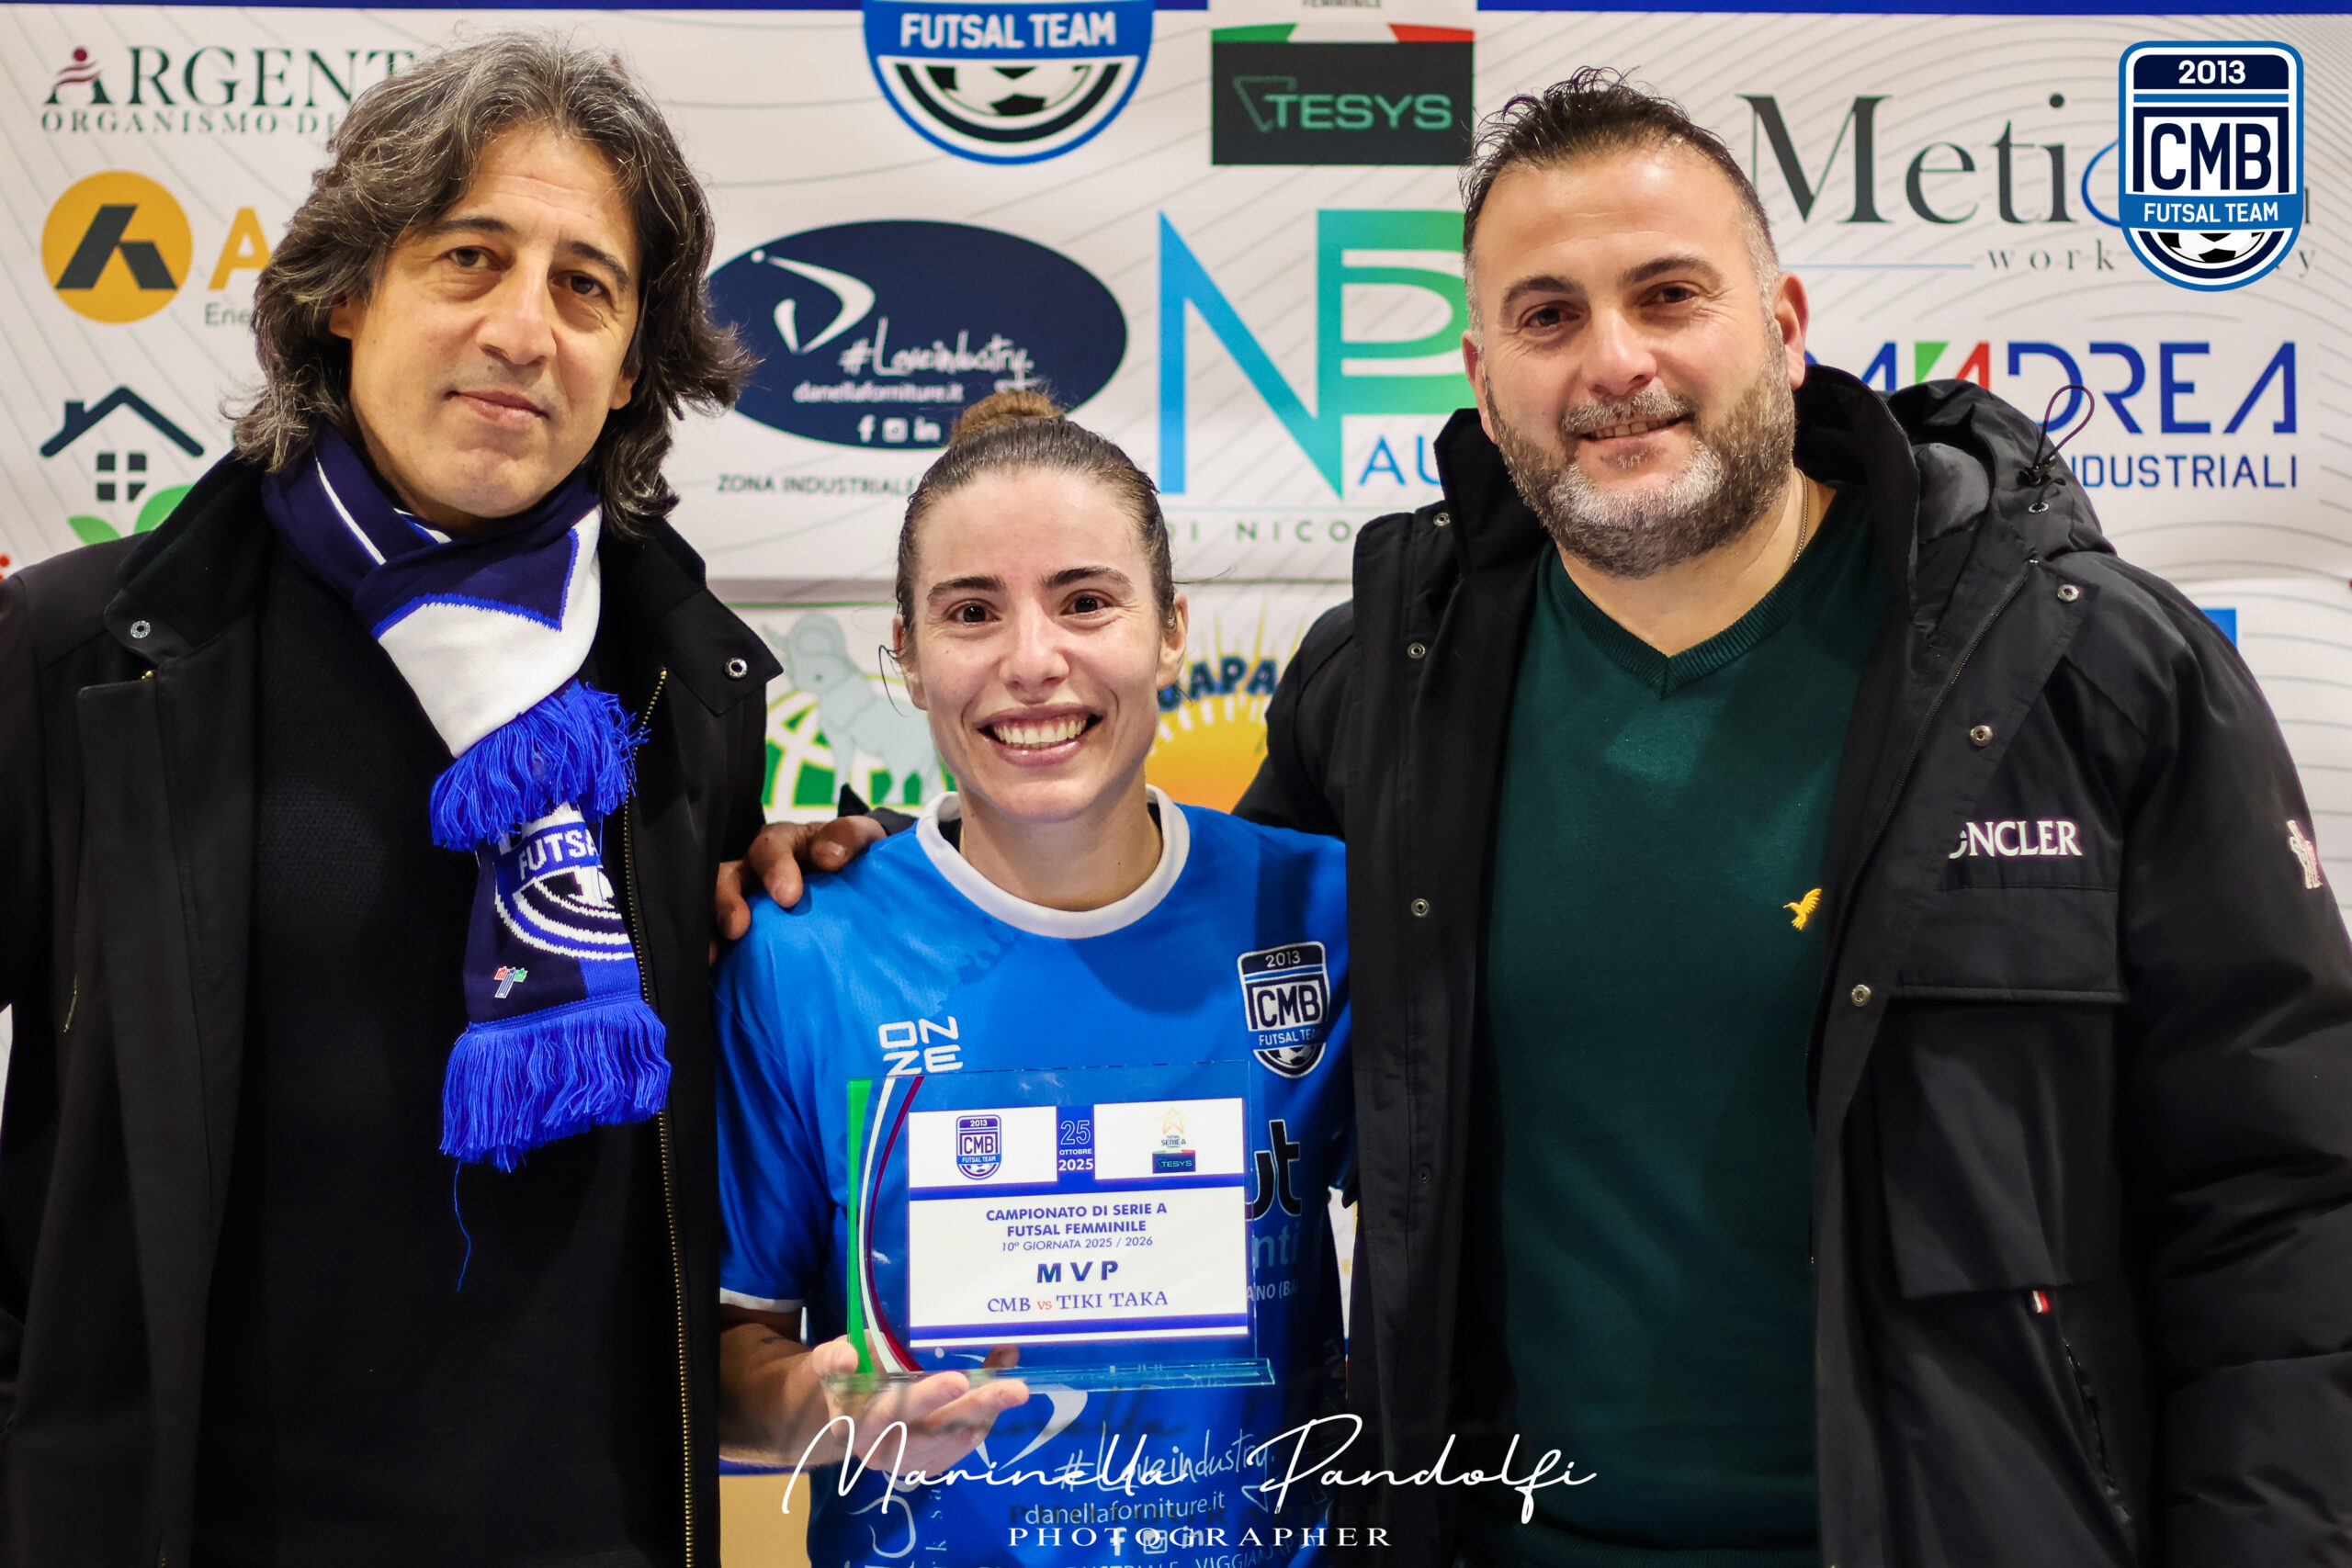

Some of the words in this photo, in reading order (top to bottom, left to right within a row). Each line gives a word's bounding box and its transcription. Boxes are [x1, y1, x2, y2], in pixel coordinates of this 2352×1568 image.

[899, 13, 1025, 50] FUTSAL
[1027, 11, 1117, 48] TEAM
[1262, 93, 1453, 130] TESYS
[40, 109, 277, 135] ORGANISMO
[2071, 454, 2298, 489] DUSTRIALI
[717, 474, 775, 492] ZONA
[1264, 950, 1301, 968] 2013
[1256, 984, 1321, 1028] CMB
[1259, 1030, 1299, 1046] FUTSAL
[1299, 1026, 1324, 1041] TEA
[969, 1119, 989, 1128] 2013
[1059, 1119, 1091, 1145] 25
[963, 1134, 995, 1156] CMB
[1058, 1148, 1093, 1156] OTTOBRE
[961, 1156, 982, 1164] FUTSAL
[982, 1155, 998, 1163] TEAM
[1057, 1157, 1095, 1172] 2025
[1160, 1159, 1193, 1168] TESYS
[986, 1205, 1088, 1222] CAMPIONATO
[1091, 1204, 1108, 1217] DI
[1113, 1202, 1152, 1216] SERIE
[1156, 1201, 1168, 1214] A
[1007, 1224, 1061, 1237] FUTSAL
[1065, 1220, 1148, 1235] FEMMINILE
[1023, 1239, 1082, 1251] GIORNATA
[1084, 1236, 1114, 1249] 2025
[1125, 1235, 1154, 1247] 2026
[987, 1296, 1032, 1314] CMB
[1056, 1293, 1103, 1310] TIKI
[1108, 1290, 1170, 1309] TAKA
[1024, 1490, 1226, 1526] danellaforniture.it
